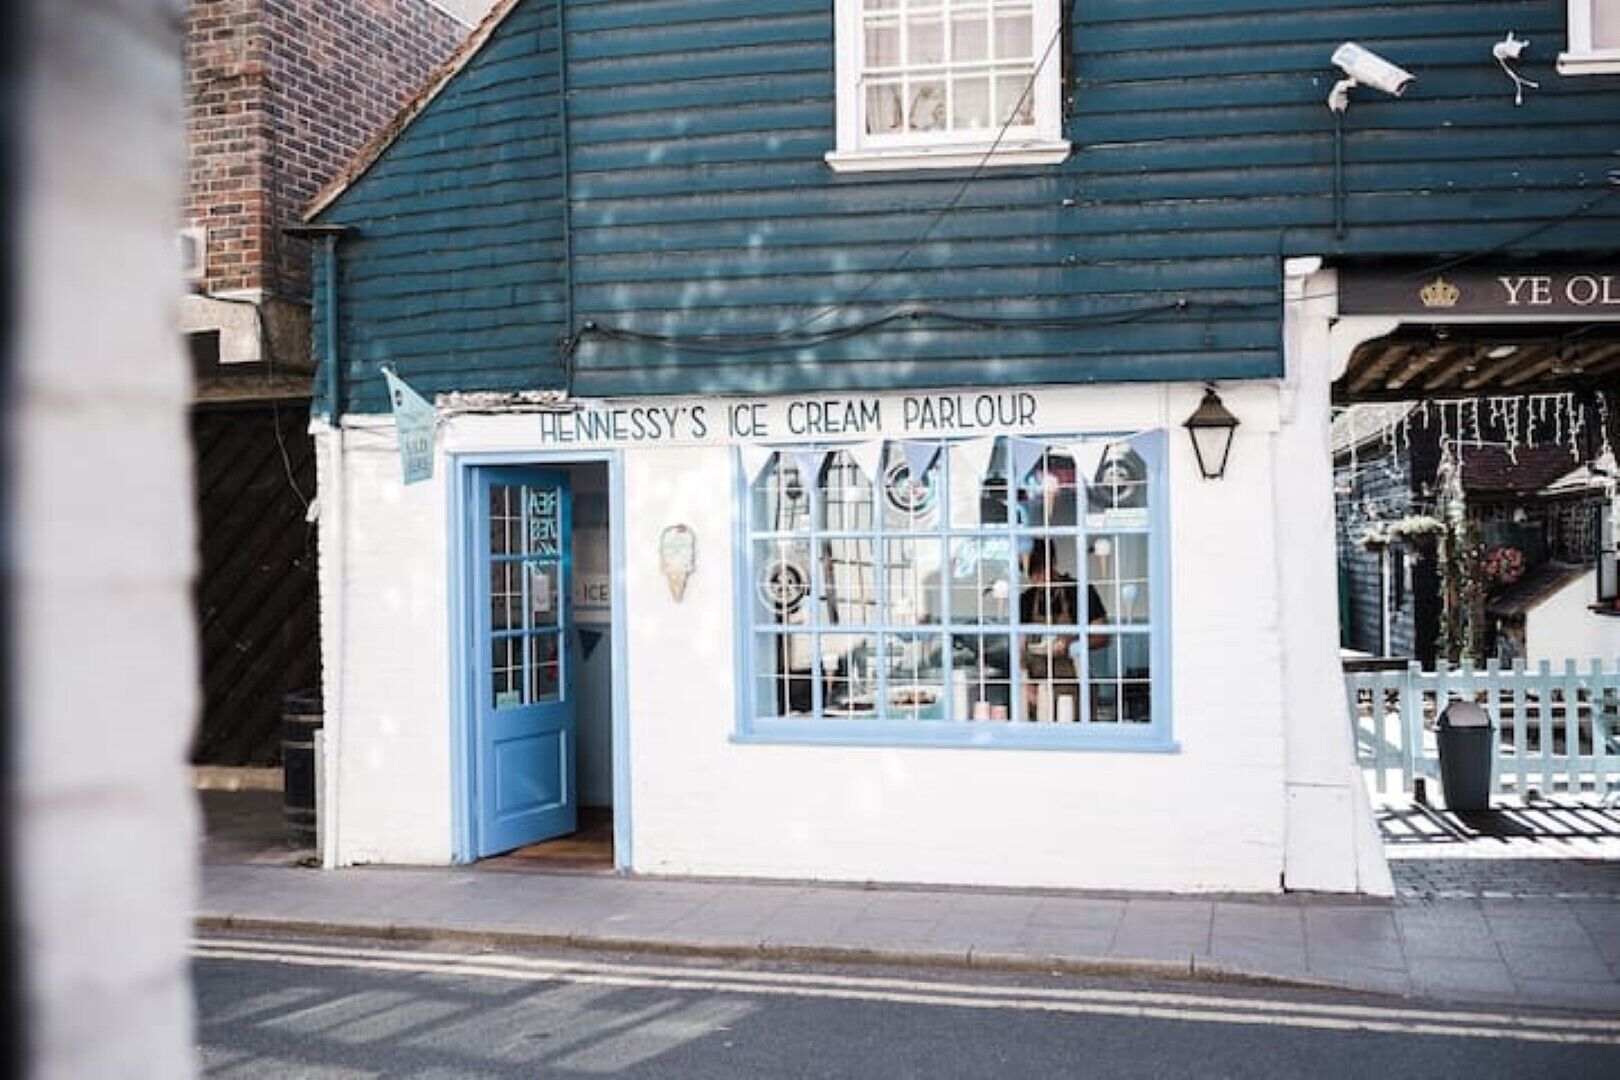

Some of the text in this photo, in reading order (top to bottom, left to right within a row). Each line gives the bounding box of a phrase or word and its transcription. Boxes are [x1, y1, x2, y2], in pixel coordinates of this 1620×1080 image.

[1499, 275, 1620, 305] YE OL
[541, 392, 1037, 442] HENNESSY'S ICE CREAM PARLOUR
